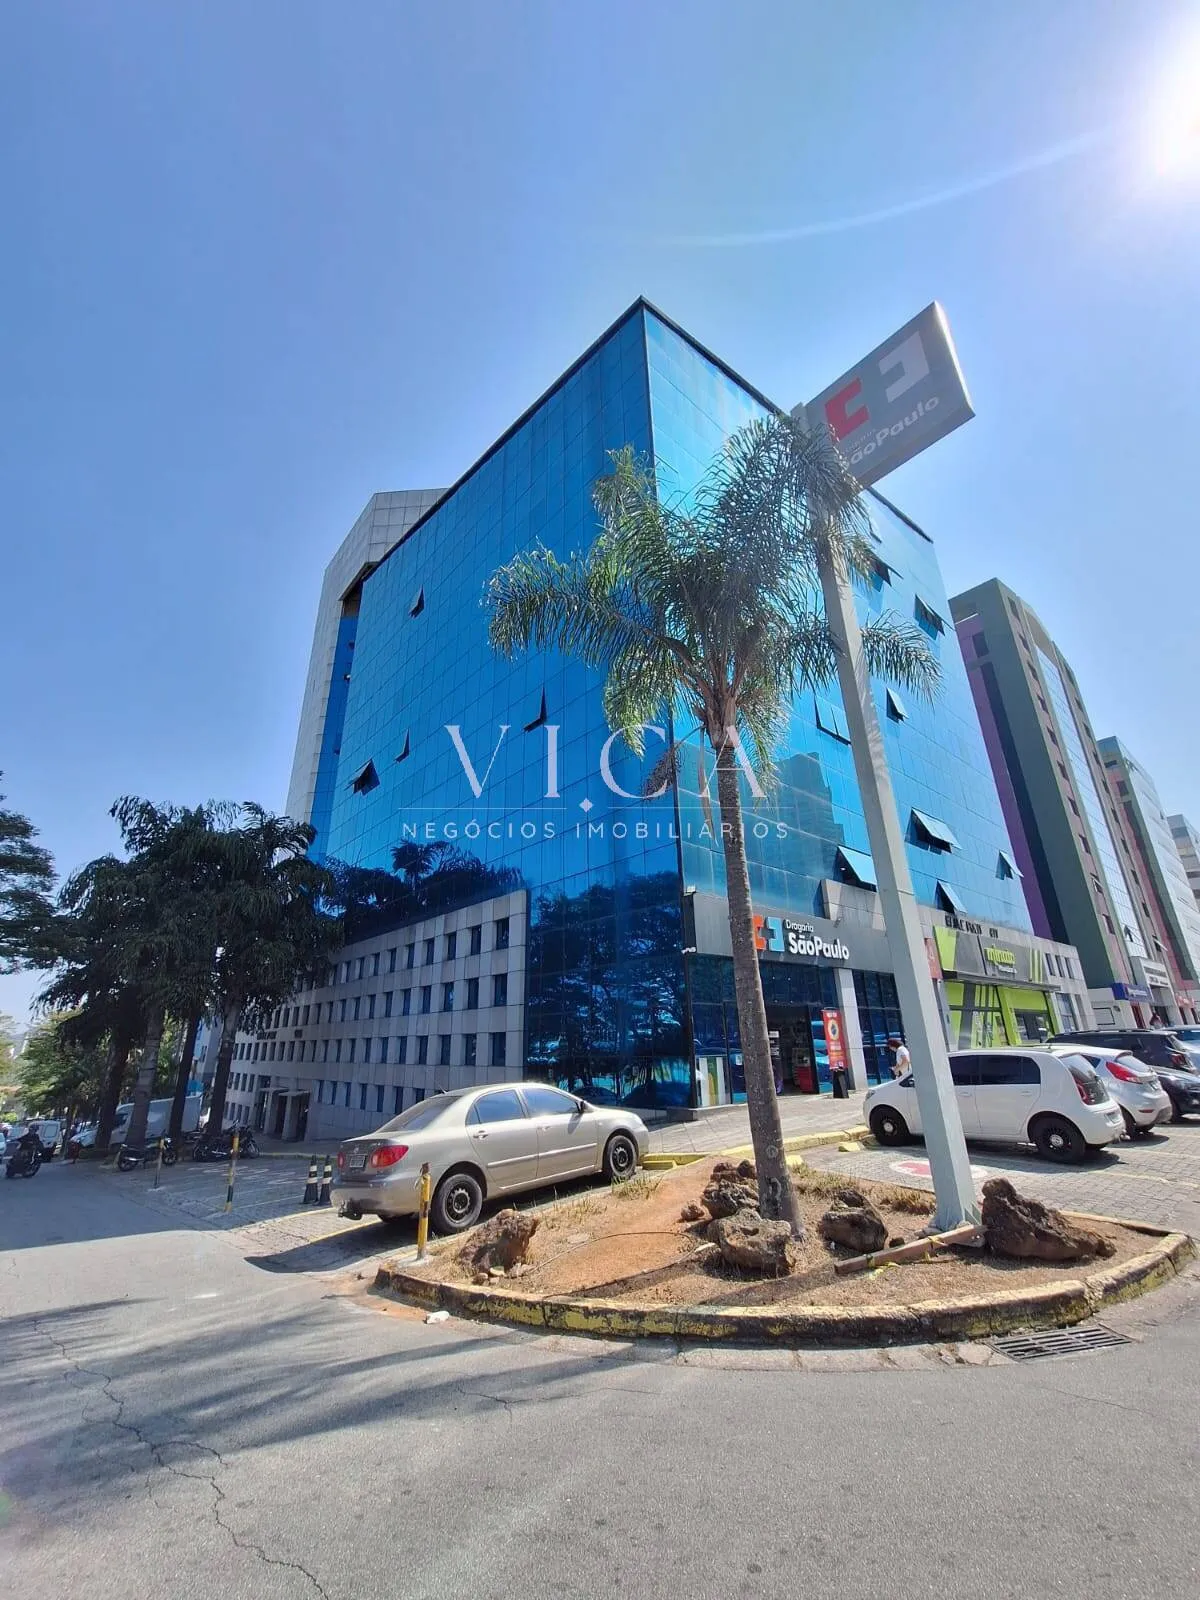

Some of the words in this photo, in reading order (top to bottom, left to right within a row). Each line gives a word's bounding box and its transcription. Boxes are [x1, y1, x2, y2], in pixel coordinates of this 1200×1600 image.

[849, 396, 939, 466] ãoPaulo
[786, 919, 814, 933] Drogaria
[788, 932, 850, 960] SãoPaulo
